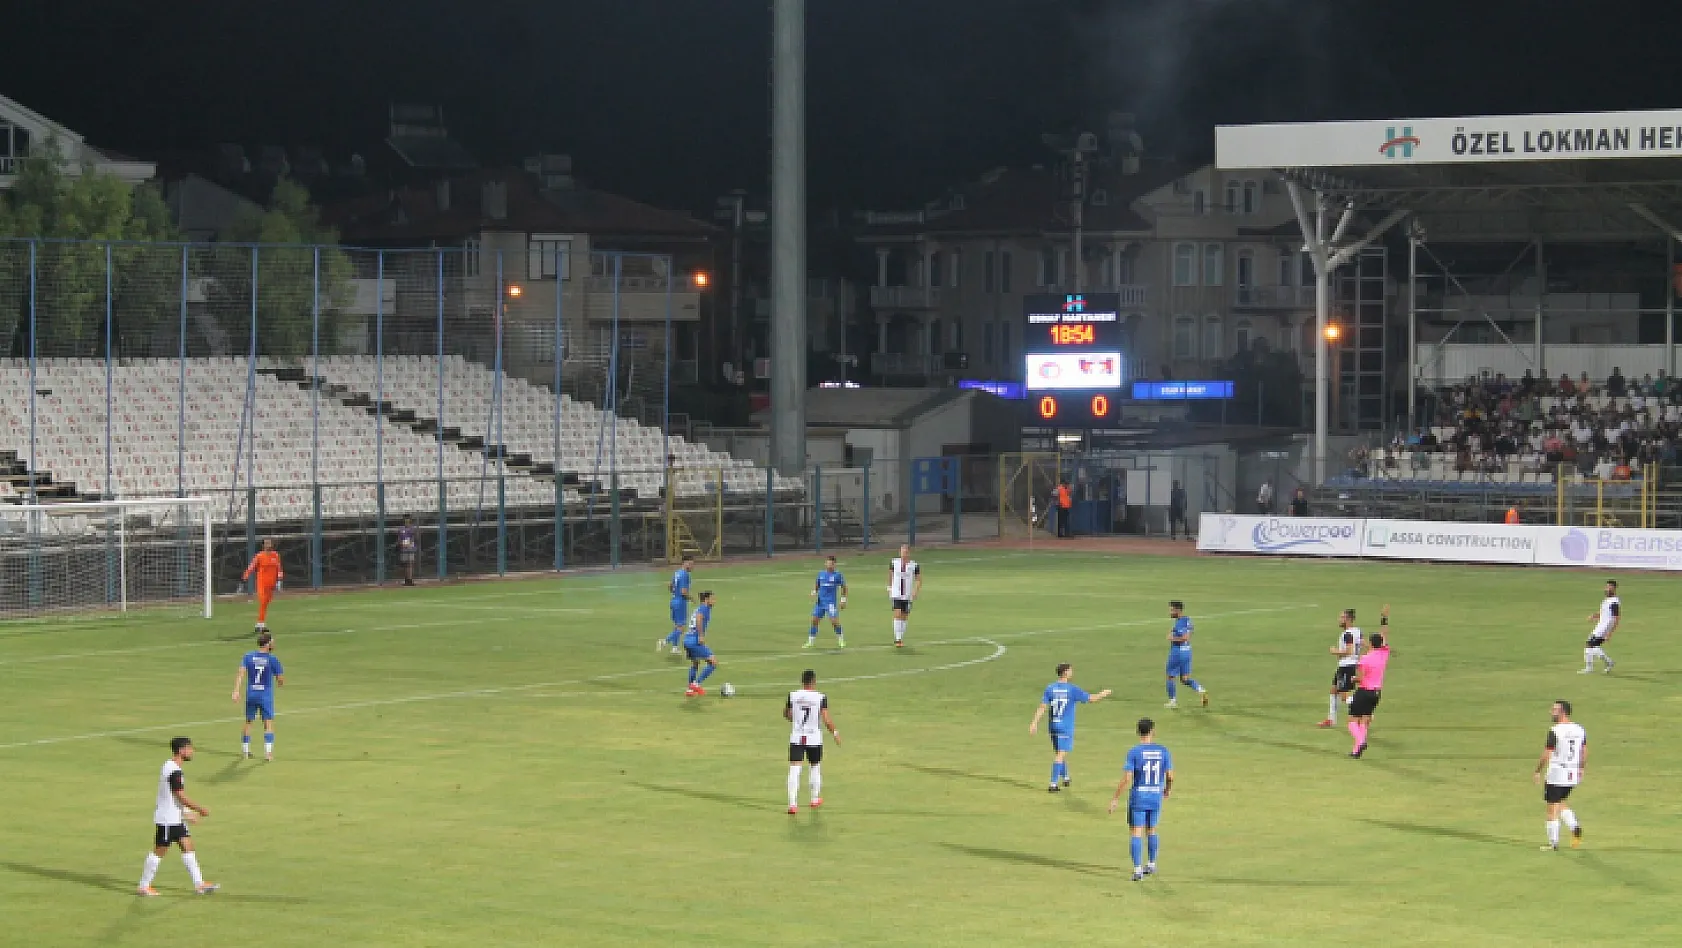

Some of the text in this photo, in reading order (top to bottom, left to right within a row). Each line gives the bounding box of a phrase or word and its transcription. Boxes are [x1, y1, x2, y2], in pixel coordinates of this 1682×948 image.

[1452, 126, 1515, 155] ÖZEL
[1523, 128, 1631, 153] LOKMAN
[1041, 395, 1107, 418] 0 0
[1269, 518, 1356, 540] Powerpool
[1390, 532, 1532, 550] ASSA CONSTRUCTION
[254, 665, 265, 684] 7
[801, 705, 811, 724] 7
[1051, 699, 1069, 716] 17
[1142, 760, 1160, 785] 11
